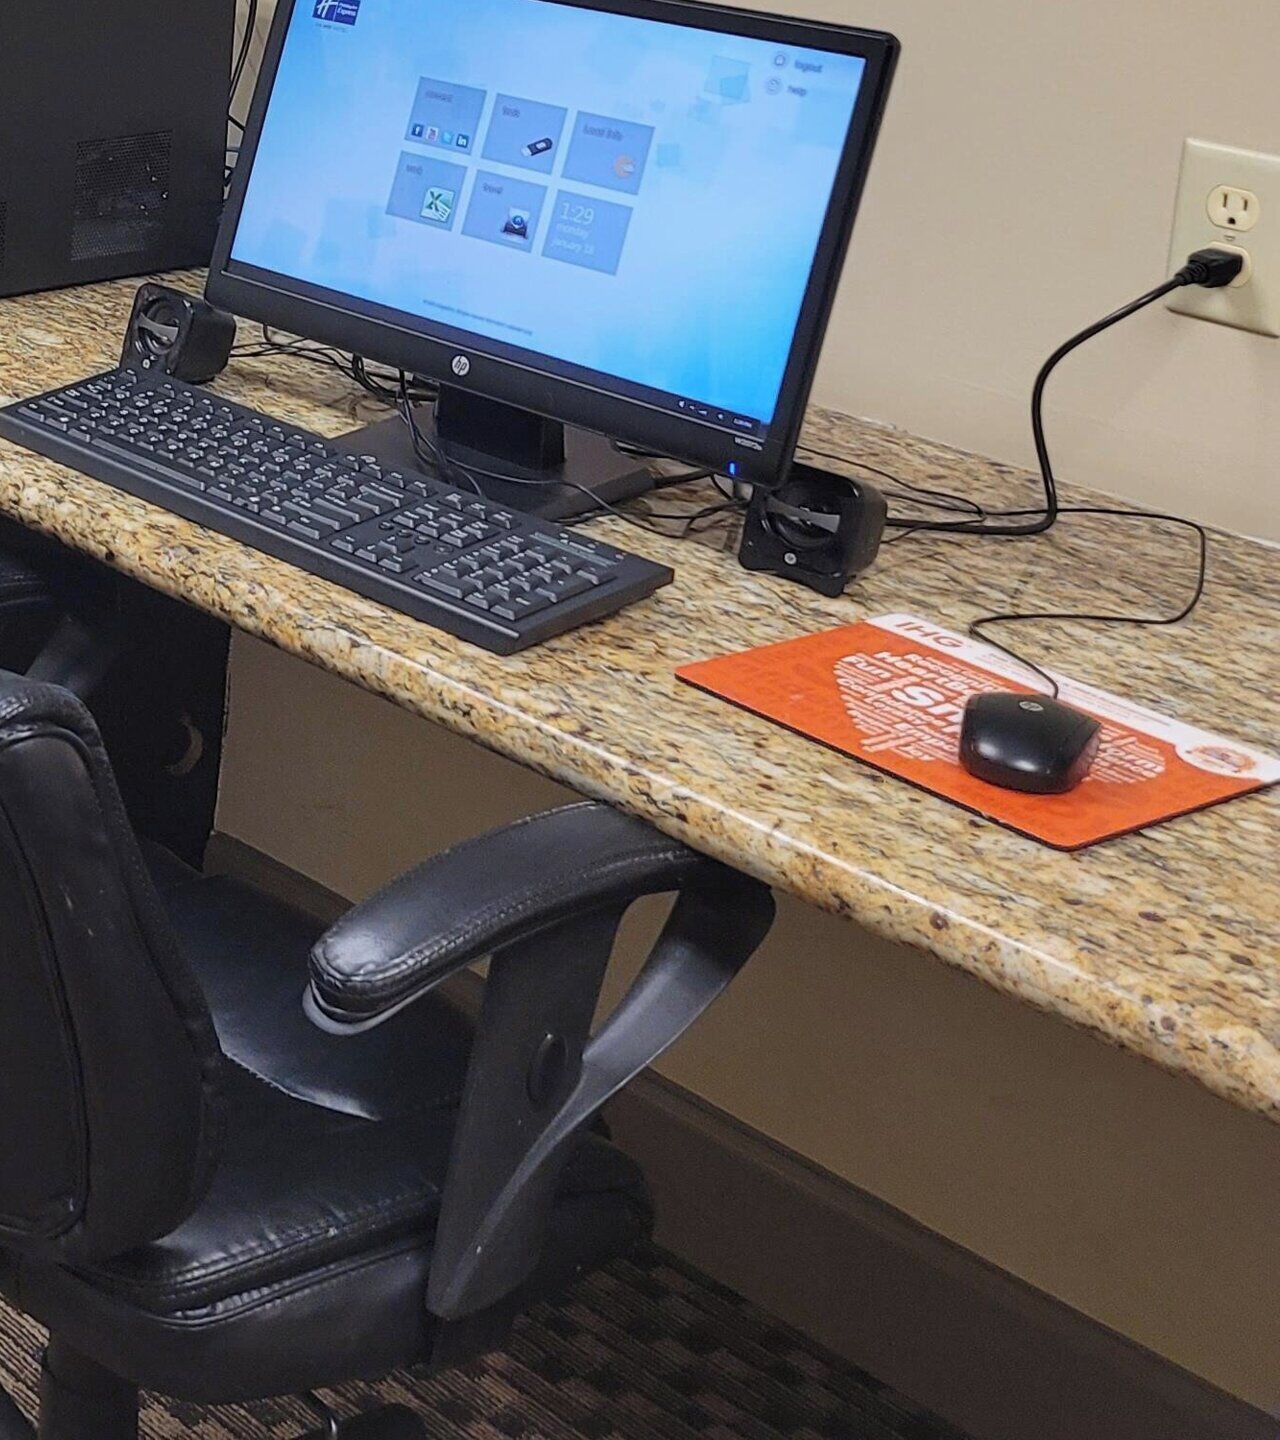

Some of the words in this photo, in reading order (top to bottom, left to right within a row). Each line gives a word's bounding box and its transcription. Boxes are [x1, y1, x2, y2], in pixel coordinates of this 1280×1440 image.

[560, 201, 595, 226] 1:29
[452, 355, 470, 376] hp
[895, 621, 964, 649] IHG
[839, 654, 893, 680] Fun
